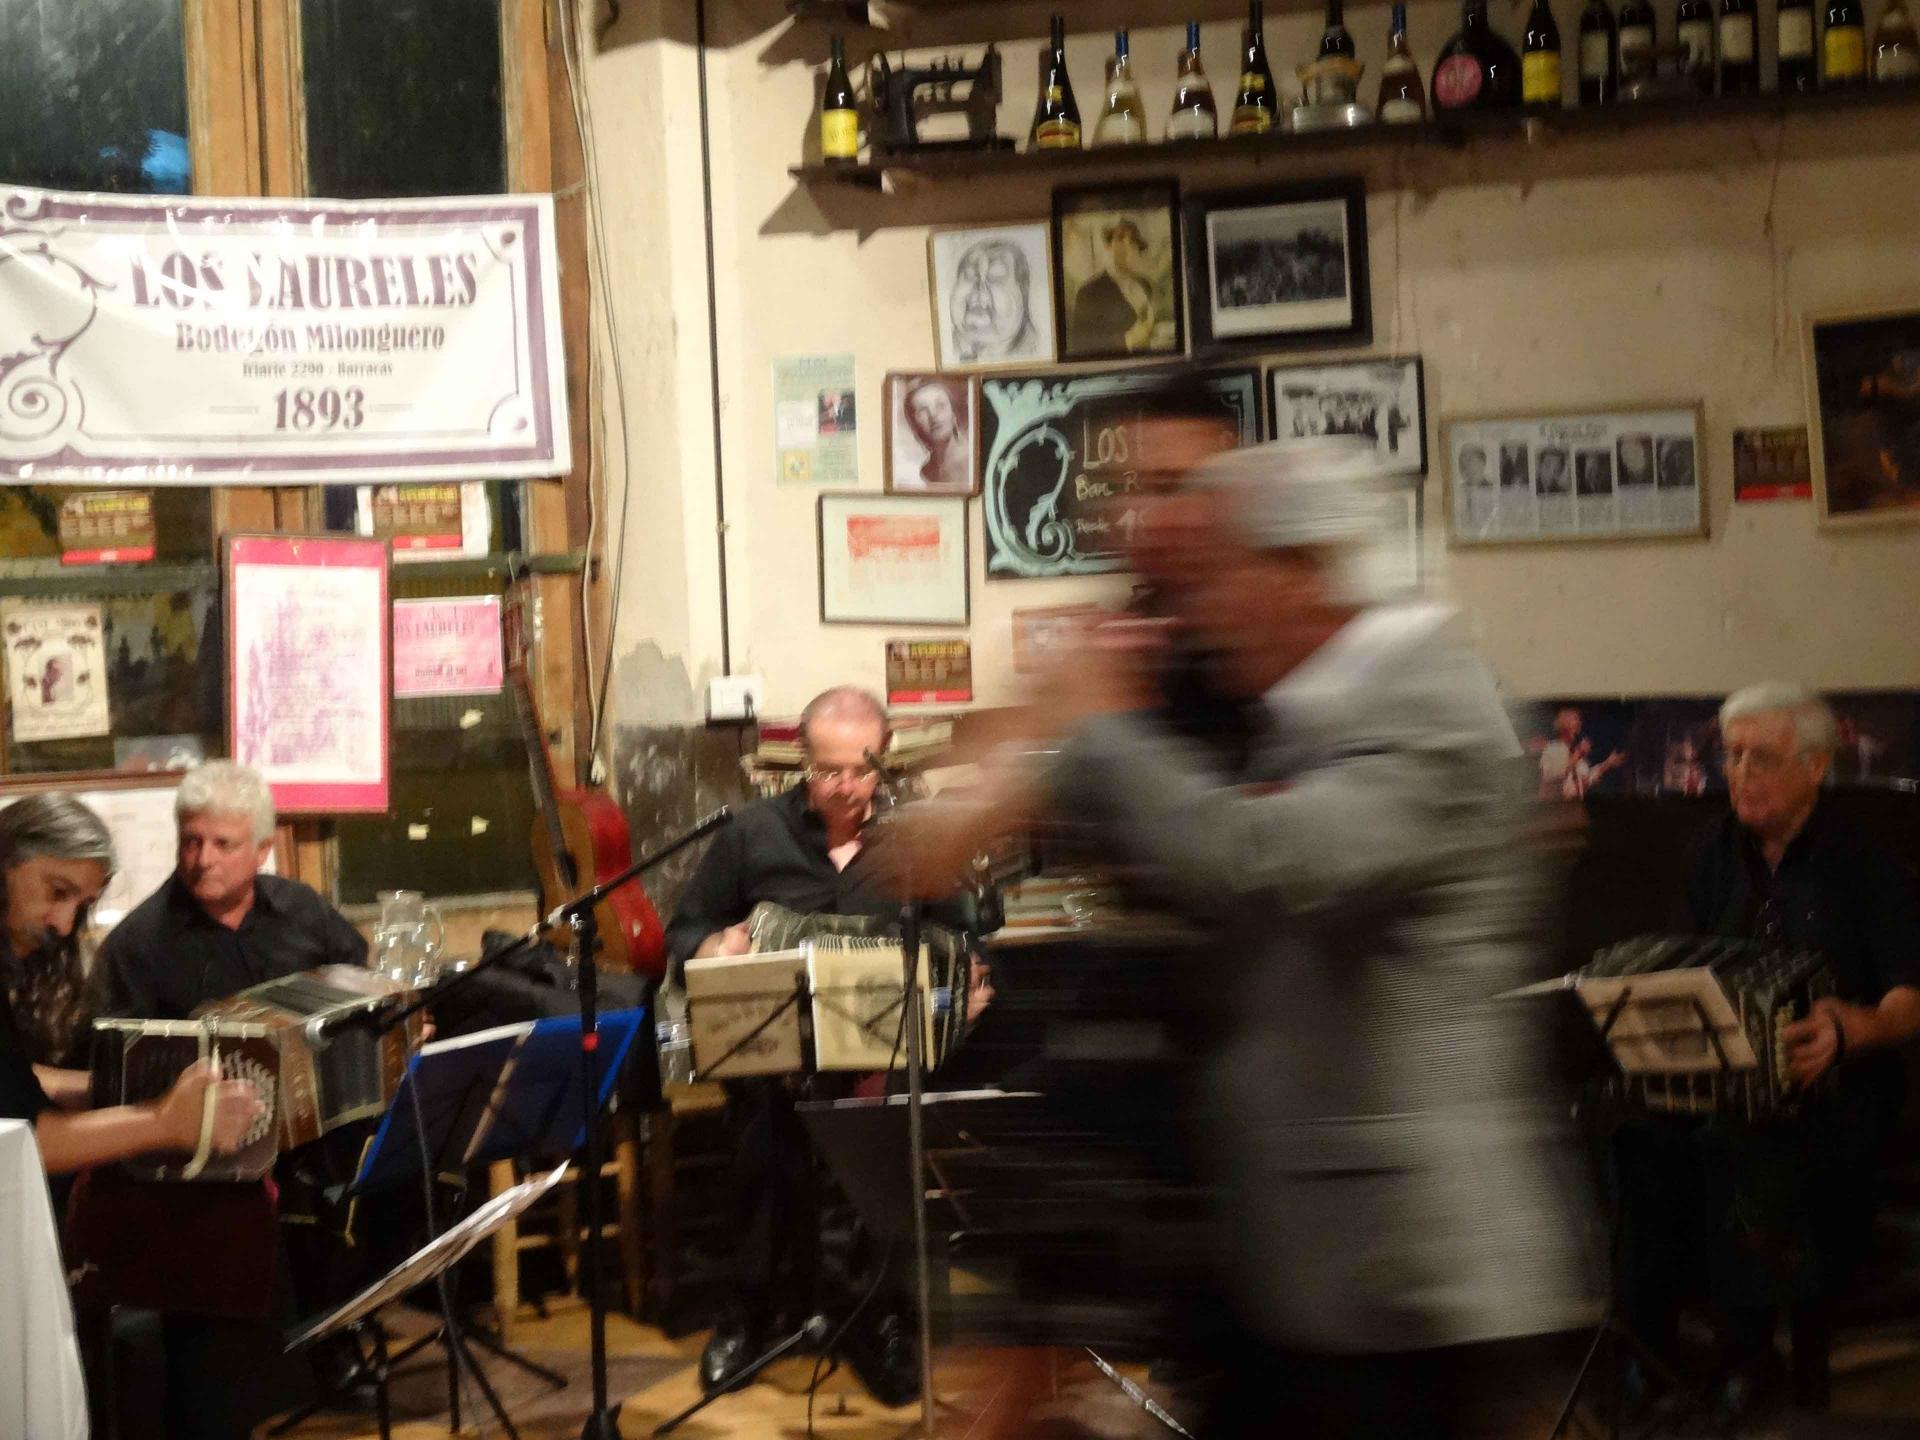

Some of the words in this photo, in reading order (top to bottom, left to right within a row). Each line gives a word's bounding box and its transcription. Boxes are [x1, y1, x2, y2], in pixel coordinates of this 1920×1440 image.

[132, 251, 224, 309] LOS
[304, 322, 446, 353] Milonguero
[274, 385, 366, 430] 1893
[1083, 419, 1129, 469] LOS
